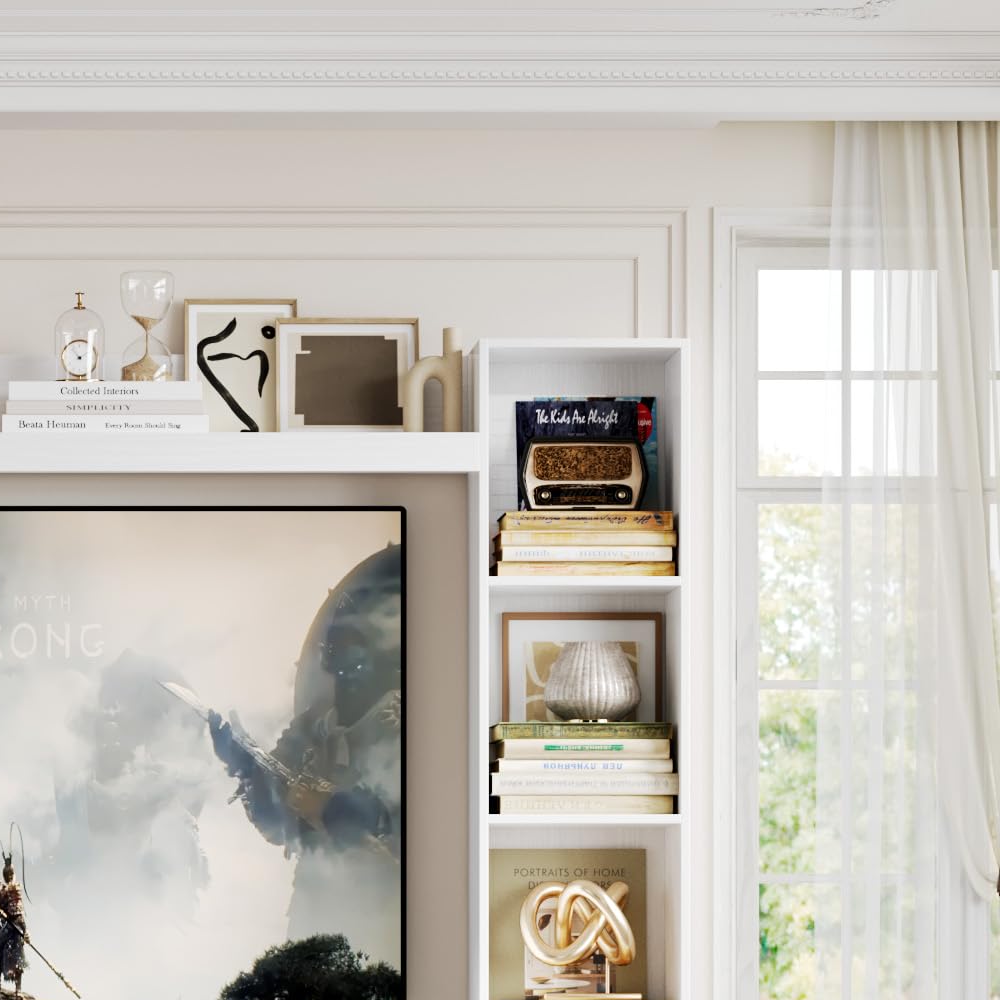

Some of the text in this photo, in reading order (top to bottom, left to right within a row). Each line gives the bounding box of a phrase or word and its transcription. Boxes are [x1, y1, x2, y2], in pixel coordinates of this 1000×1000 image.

[60, 386, 139, 396] Collected Interiors
[536, 408, 618, 430] The Kids Are Alright
[18, 420, 86, 429] Beata Heuman
[105, 422, 123, 430] Every
[15, 595, 72, 611] MYTH
[514, 868, 626, 877] PORTRAITS OF HOME
